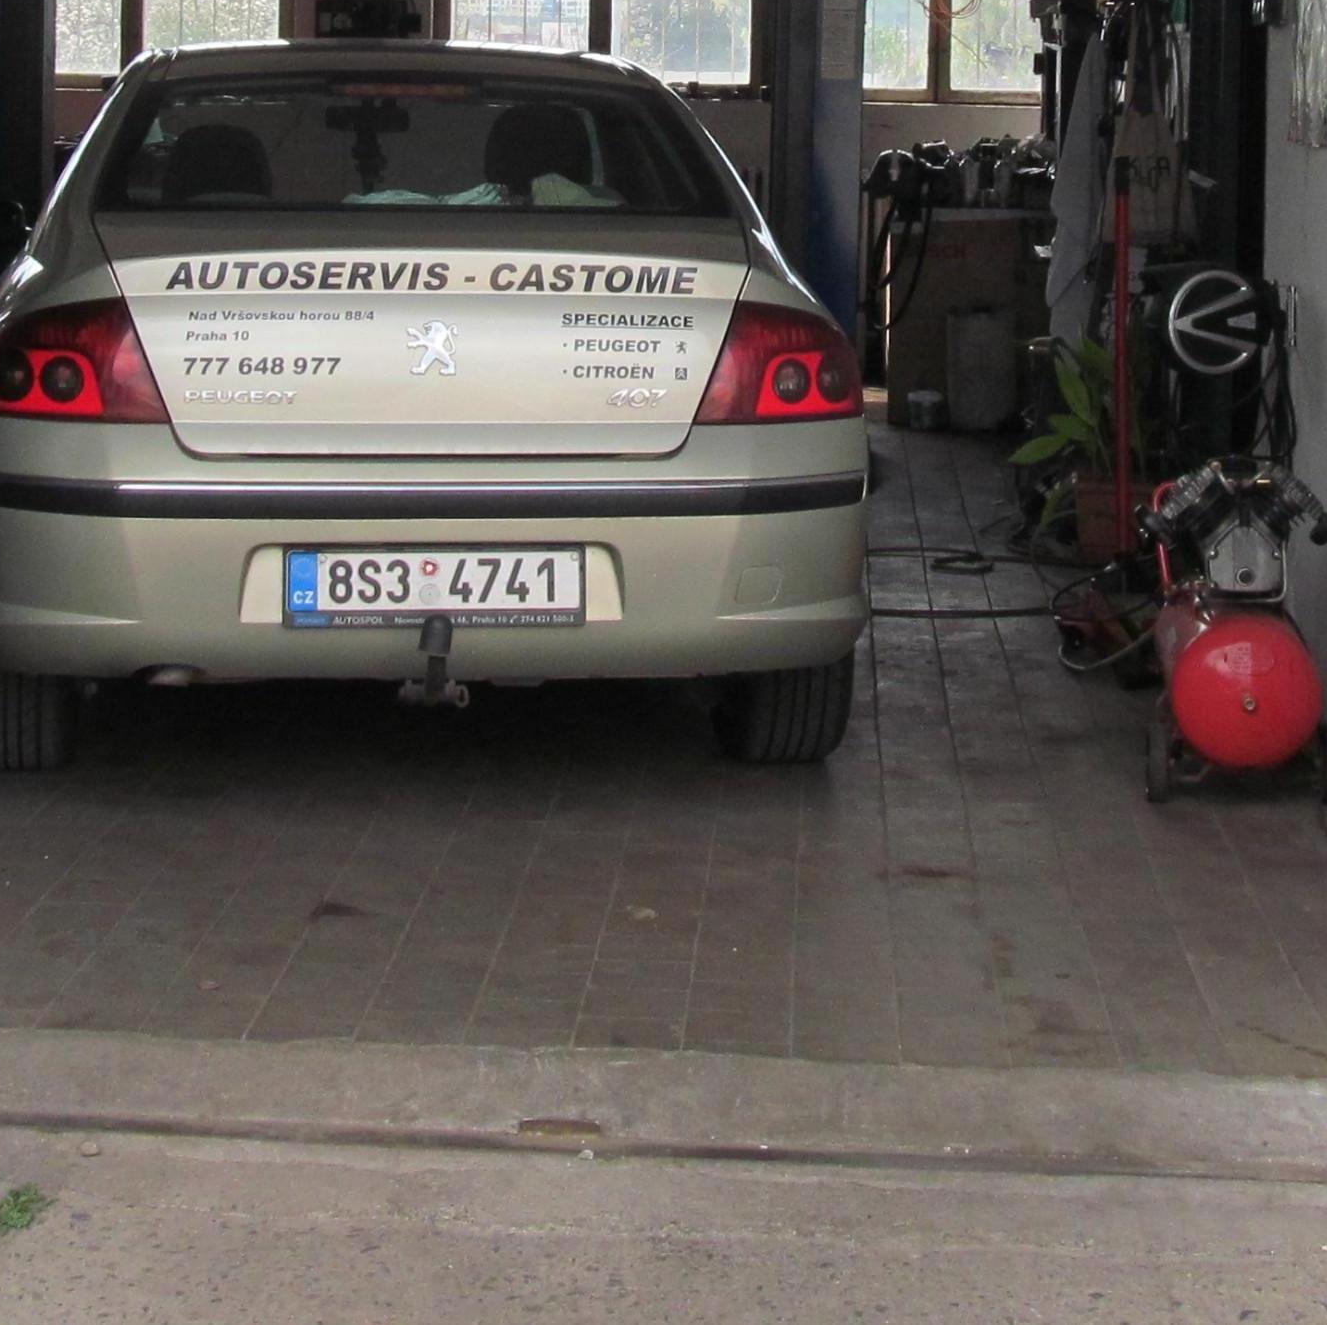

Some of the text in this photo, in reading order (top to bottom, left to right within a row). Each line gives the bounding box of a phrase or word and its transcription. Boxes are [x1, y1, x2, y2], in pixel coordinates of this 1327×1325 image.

[166, 261, 450, 291] AUTOSERVIS
[489, 263, 698, 295] CASTOME
[188, 310, 217, 321] Nad
[221, 310, 295, 322] Vršovskou
[299, 310, 340, 322] horou
[561, 313, 695, 328] SPECIALIZACE
[185, 330, 250, 342] Praha 10
[573, 339, 661, 353] PEUGEOT
[183, 357, 342, 376] 777 648 977
[572, 363, 655, 380] CITROËN
[184, 389, 298, 405] PEUGEOT
[607, 388, 668, 408] 407
[328, 557, 555, 604] 8S3 4741
[293, 590, 315, 605] CZ
